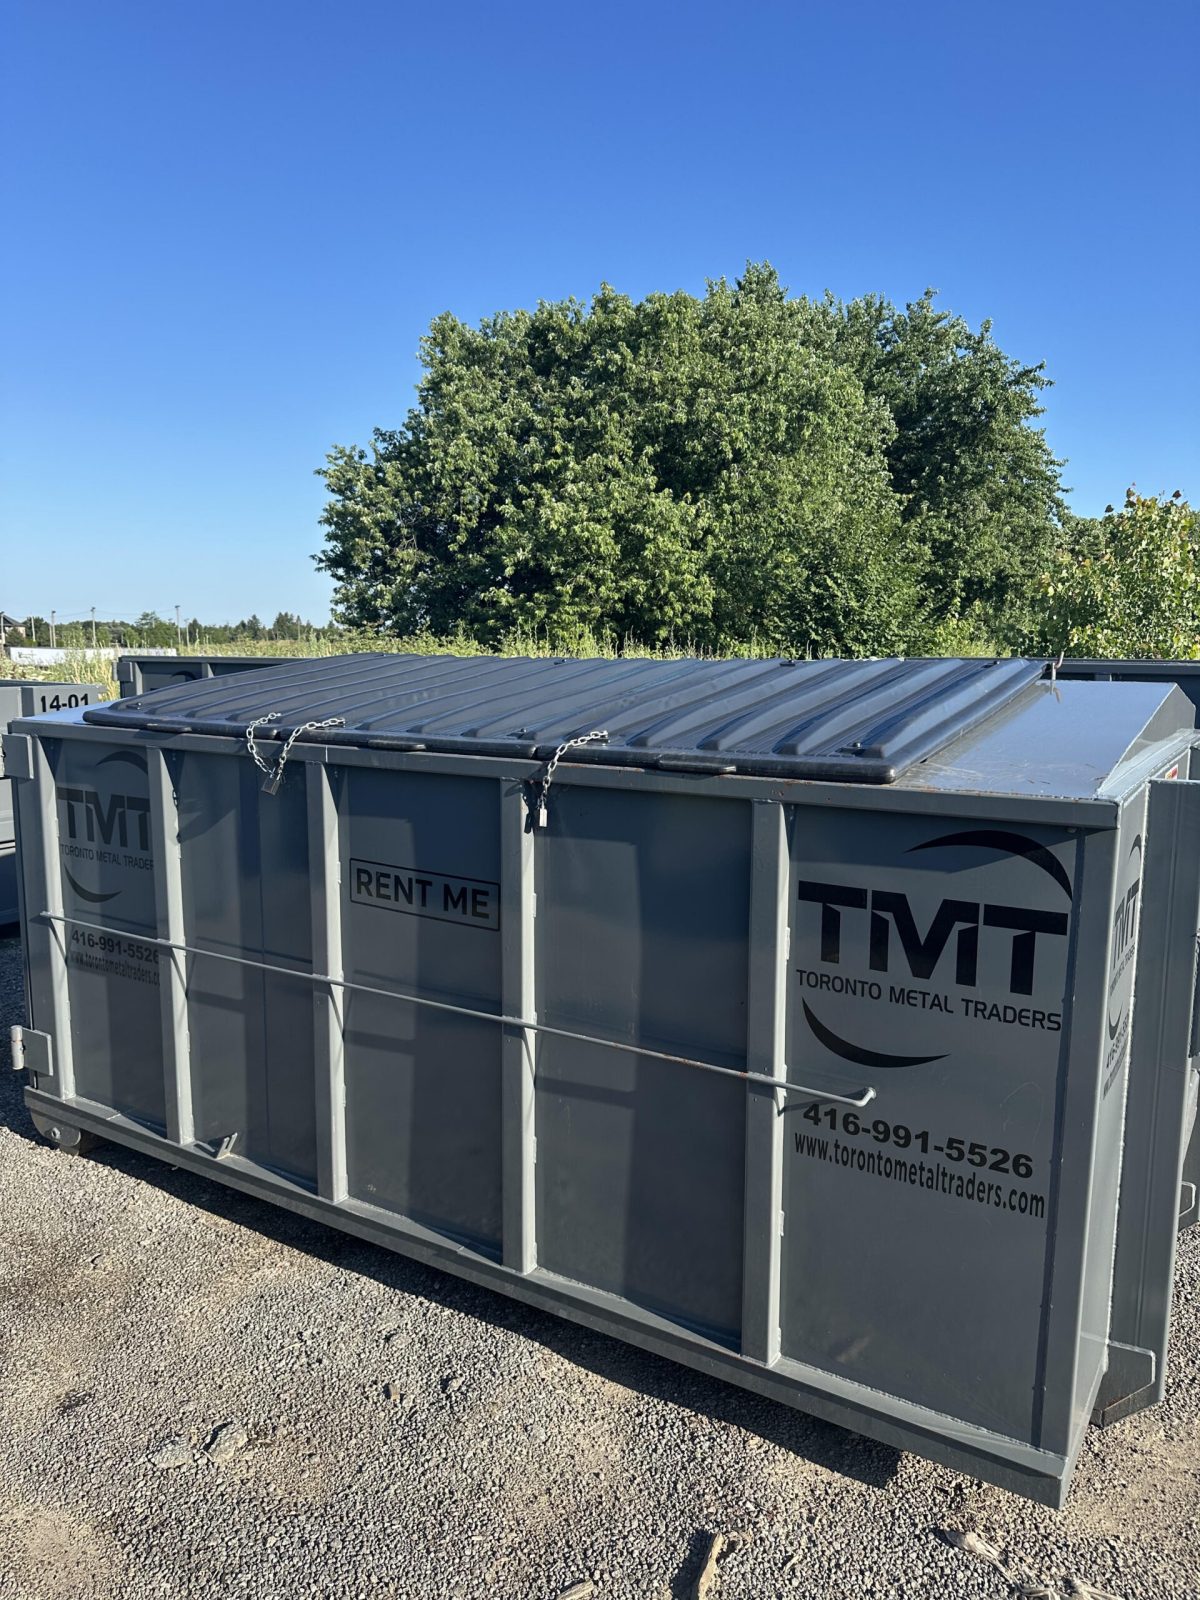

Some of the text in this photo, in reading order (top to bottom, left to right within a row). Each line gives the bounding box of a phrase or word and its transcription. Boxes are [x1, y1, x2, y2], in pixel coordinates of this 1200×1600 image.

[40, 693, 89, 713] 14-01
[56, 786, 151, 851] TMT
[356, 868, 490, 919] RENT ME
[798, 881, 1069, 996] TMT
[796, 969, 1062, 1032] TORONTO METAL TRADERS
[803, 1103, 1034, 1179] 416-991-5526
[794, 1132, 1045, 1218] www.torontometaltraders.com
